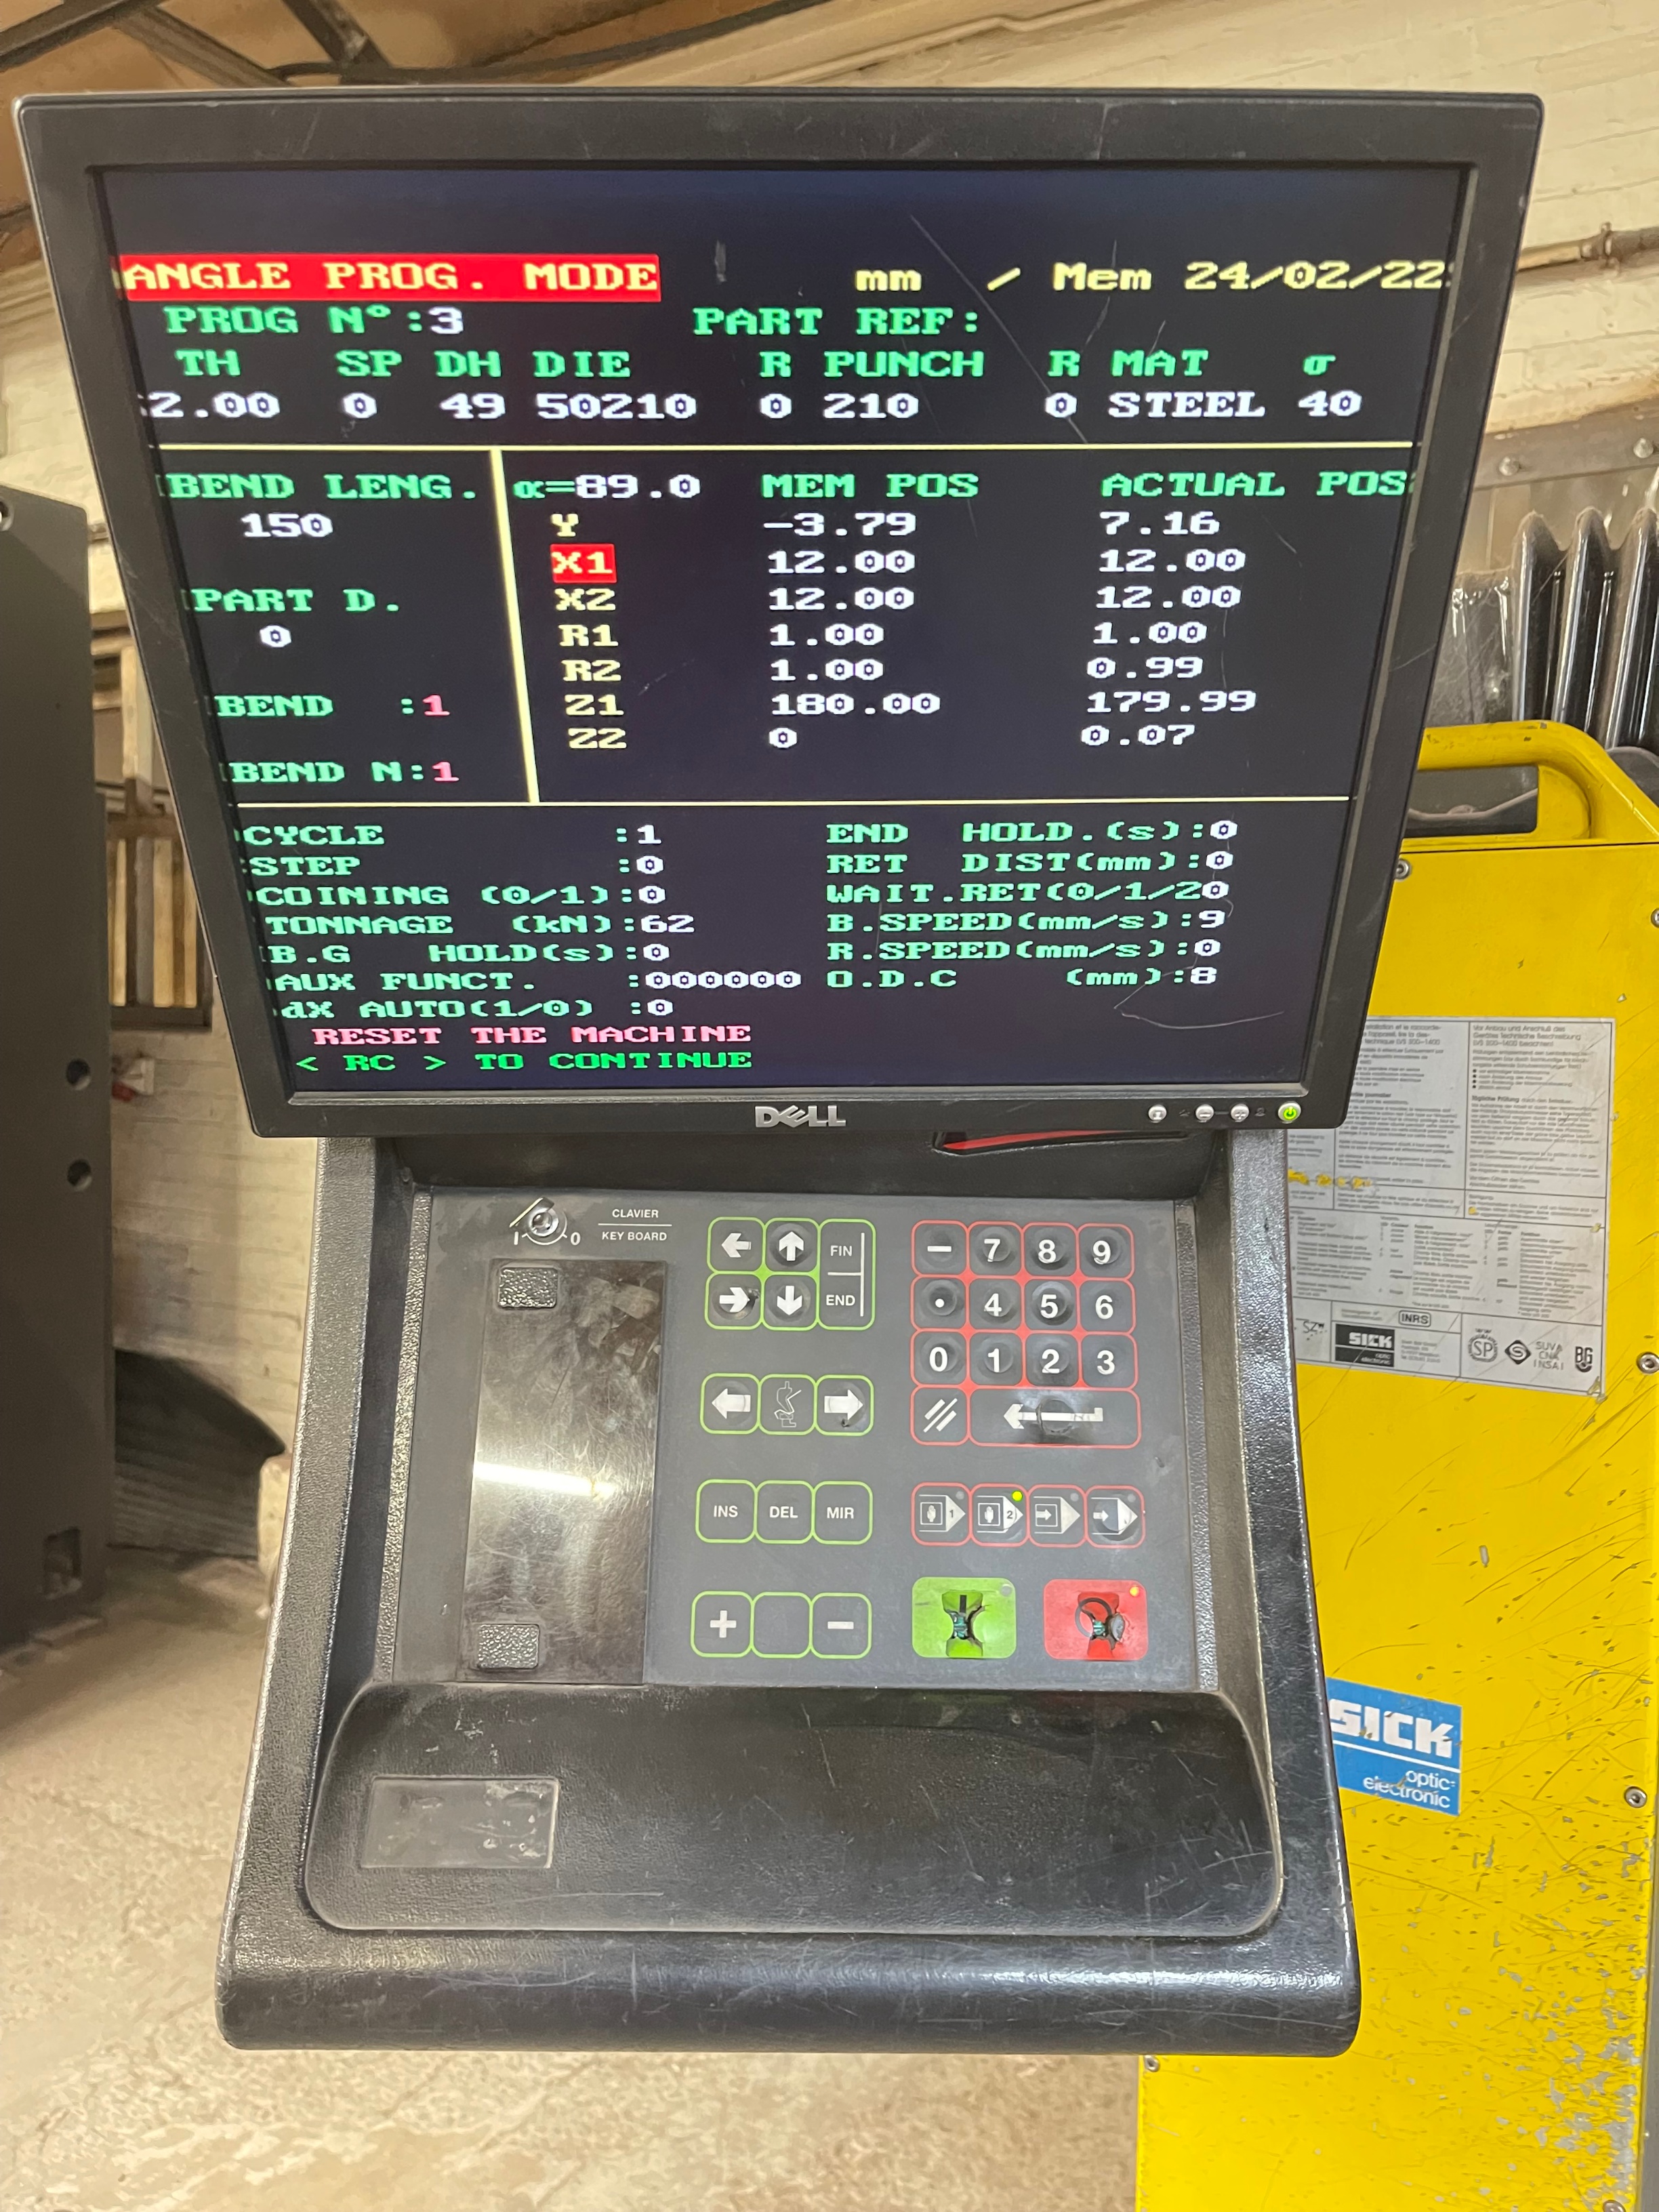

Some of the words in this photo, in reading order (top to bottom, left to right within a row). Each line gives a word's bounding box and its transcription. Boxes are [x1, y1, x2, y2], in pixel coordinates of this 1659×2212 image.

[127, 263, 290, 289] ANGLE
[324, 263, 482, 289] PROG.
[525, 264, 657, 289] MODE
[857, 270, 921, 291] mm
[987, 268, 1020, 290] /
[1054, 263, 1151, 290] Mem
[1185, 261, 1444, 289] 24/02/22
[163, 306, 298, 333] PROG
[329, 305, 464, 334] N°:3
[693, 308, 822, 335] PART
[857, 308, 977, 334] REF:
[176, 350, 240, 375] TH
[336, 350, 401, 376] SP
[434, 351, 501, 377] DH
[533, 351, 630, 377] DIE
[760, 352, 791, 377] R
[824, 351, 983, 377] PUNCH
[1048, 350, 1080, 376] R
[1112, 350, 1208, 376] MAT
[1304, 355, 1336, 375] σ
[149, 392, 280, 417] 2.00
[343, 393, 377, 418] 0
[441, 393, 505, 419] 49
[537, 394, 696, 419] 50210
[760, 394, 792, 418] 0
[823, 393, 918, 418] 210
[1045, 393, 1077, 417] 0
[1109, 392, 1265, 417] STEEL
[1298, 390, 1361, 416] 40
[166, 474, 294, 498] BEND
[324, 474, 475, 499] LENG.
[514, 474, 700, 498] α=89.0
[762, 474, 855, 497] MEM
[886, 474, 979, 497] POS
[1102, 472, 1285, 496] ACTUAL
[1317, 471, 1406, 495] POS
[241, 514, 333, 537] 150
[551, 514, 578, 536] Y
[764, 512, 916, 535] -3.79
[1100, 511, 1219, 535] 7.16
[553, 552, 612, 573] X1
[769, 550, 915, 573] 12.00
[1099, 549, 1246, 571] 12.00
[193, 589, 312, 611] PART
[343, 590, 398, 611] D.
[555, 588, 615, 611] X2
[769, 588, 914, 610] 12.00
[1097, 586, 1241, 608] 12.00
[260, 626, 291, 647] 0
[558, 625, 618, 646] R1
[771, 623, 884, 646] 1.00
[1093, 622, 1207, 644] 1.00
[561, 660, 621, 681] R2
[771, 659, 883, 680] 1.00
[1087, 657, 1203, 678] 0.99
[216, 695, 333, 716] BEND
[401, 695, 449, 716] :1
[565, 695, 623, 715] Z1
[772, 693, 940, 714] 180.00
[1088, 691, 1256, 712] 179.99
[569, 729, 626, 749] Z2
[769, 728, 797, 747] 0
[1082, 724, 1195, 745] 0.07
[230, 762, 344, 782] BEND
[371, 762, 459, 781] N:1
[244, 825, 384, 845] CYCLE
[617, 825, 661, 844] :1
[827, 824, 908, 842] END
[963, 821, 1237, 842] HOLD.(s):0
[250, 857, 360, 876] STEP
[619, 856, 663, 874] :0
[827, 855, 907, 873] RET
[962, 851, 1233, 872] DIST(mm):0
[256, 886, 449, 905] COINING
[482, 886, 665, 904] (0/1):0
[827, 881, 1229, 903] WAIT.RET(0/1/20
[265, 916, 453, 934] TONNAGE
[513, 915, 694, 933] (kN):62
[827, 910, 1225, 931] B.SPEED(mm/s):9
[268, 945, 350, 963] B.G
[429, 944, 669, 962] HOLD(s):0
[827, 939, 1221, 960] R.SPEED(mm/s):0
[275, 974, 355, 991] AUX
[380, 972, 534, 990] FUNCT.
[629, 971, 801, 989] :000000
[827, 970, 956, 987] O.D.C
[1067, 967, 1216, 985] (mm):8
[281, 1002, 334, 1018] dX
[360, 1000, 592, 1017] AUTO(1/0)
[631, 1000, 673, 1015] :0
[312, 1028, 441, 1044] RESET
[471, 1027, 546, 1044] THE
[571, 1025, 751, 1042] MACHINE
[296, 1057, 319, 1071] <
[343, 1055, 395, 1070] RC
[424, 1056, 446, 1069] >
[475, 1054, 523, 1069] TO
[550, 1052, 752, 1069] CONTINUE
[754, 1105, 846, 1129] DELL
[613, 1209, 658, 1218] CLAVIER
[602, 1231, 624, 1241] KEY
[628, 1231, 667, 1242] BOARD
[831, 1246, 852, 1256] FIN
[985, 1239, 1000, 1262] 7
[1038, 1240, 1056, 1263] 8
[1093, 1241, 1110, 1264] 9
[826, 1295, 855, 1305] END
[984, 1294, 1002, 1316] 4
[1041, 1294, 1058, 1318] 5
[1096, 1295, 1113, 1319] 6
[1401, 1313, 1429, 1325] INRS
[1349, 1332, 1392, 1348] SICK
[1473, 1340, 1493, 1357] SP
[930, 1347, 947, 1372] 0
[988, 1349, 999, 1372] 1
[1042, 1349, 1059, 1373] 2
[1097, 1351, 1115, 1374] 3
[714, 1505, 737, 1517] INS
[770, 1507, 798, 1518] DEL
[827, 1507, 854, 1519] MIR
[1329, 1698, 1454, 1759] SICK
[1363, 1774, 1451, 1810] electronic
